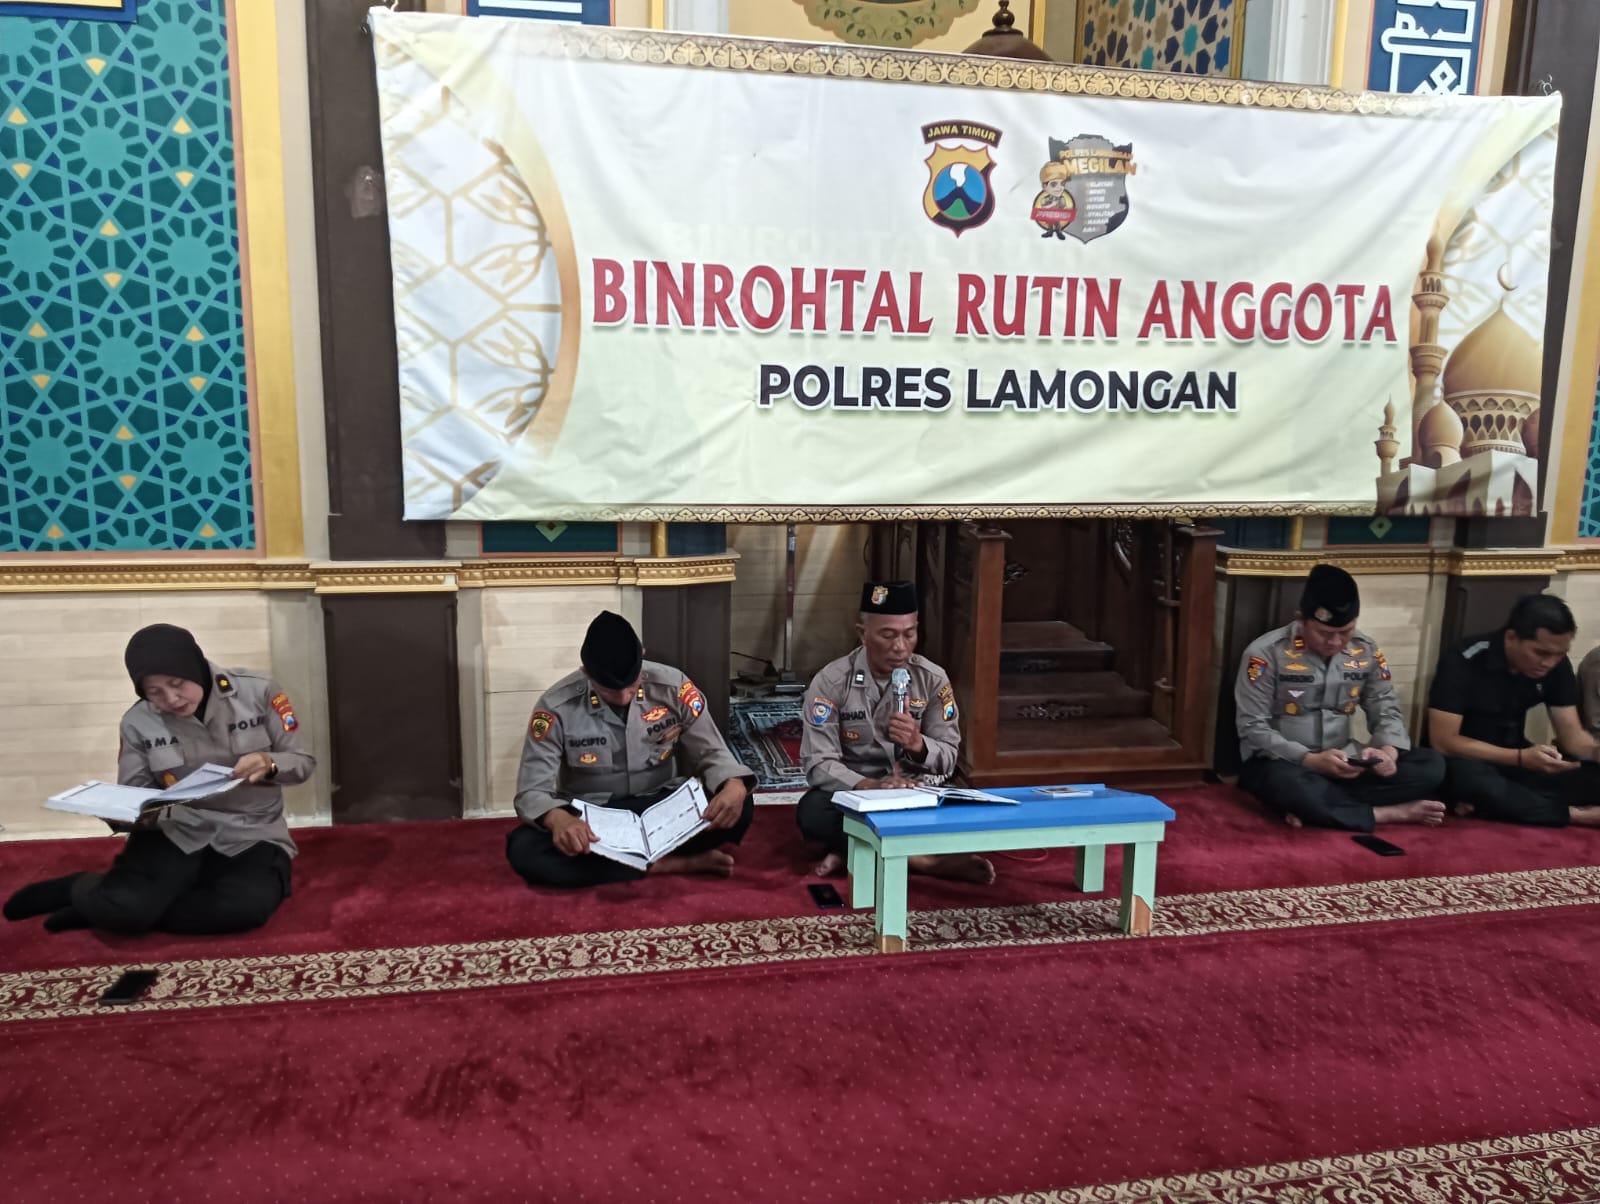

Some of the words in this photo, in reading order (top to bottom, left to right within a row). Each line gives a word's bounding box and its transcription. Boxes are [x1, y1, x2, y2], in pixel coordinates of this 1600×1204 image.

[927, 125, 958, 138] JAWA
[961, 125, 997, 142] TIMUR
[1063, 157, 1137, 176] MEGILAN
[591, 257, 934, 335] BINROHTAL
[954, 272, 1123, 339] RUTIN
[1137, 279, 1398, 344] ANGGOTA
[758, 363, 952, 410] POLRES
[965, 367, 1238, 411] LAMONGAN
[646, 717, 676, 736] POLRI
